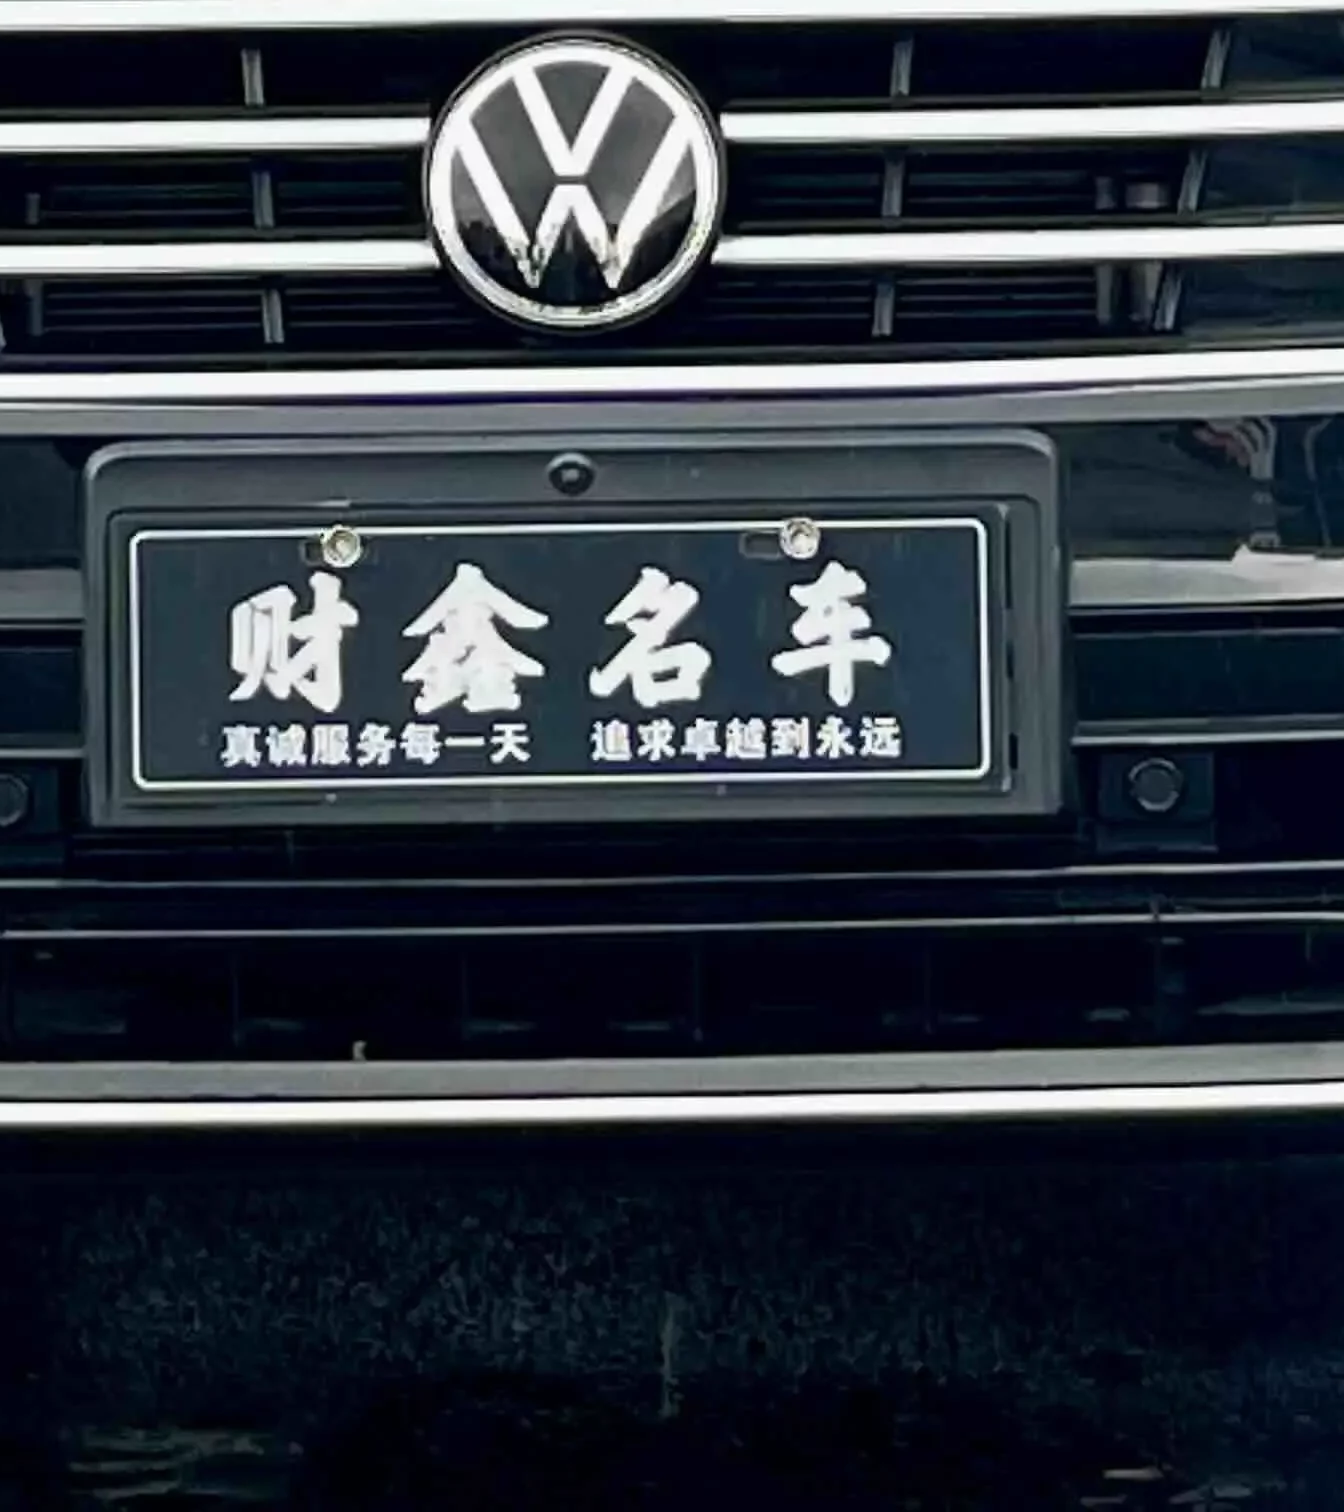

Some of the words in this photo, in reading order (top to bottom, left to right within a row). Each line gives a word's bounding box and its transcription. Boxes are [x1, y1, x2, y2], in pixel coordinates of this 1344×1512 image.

[228, 561, 893, 714] 财鑫名车
[220, 722, 531, 768] 真诚服务每一天
[590, 714, 902, 762] 追求卓越到永远
